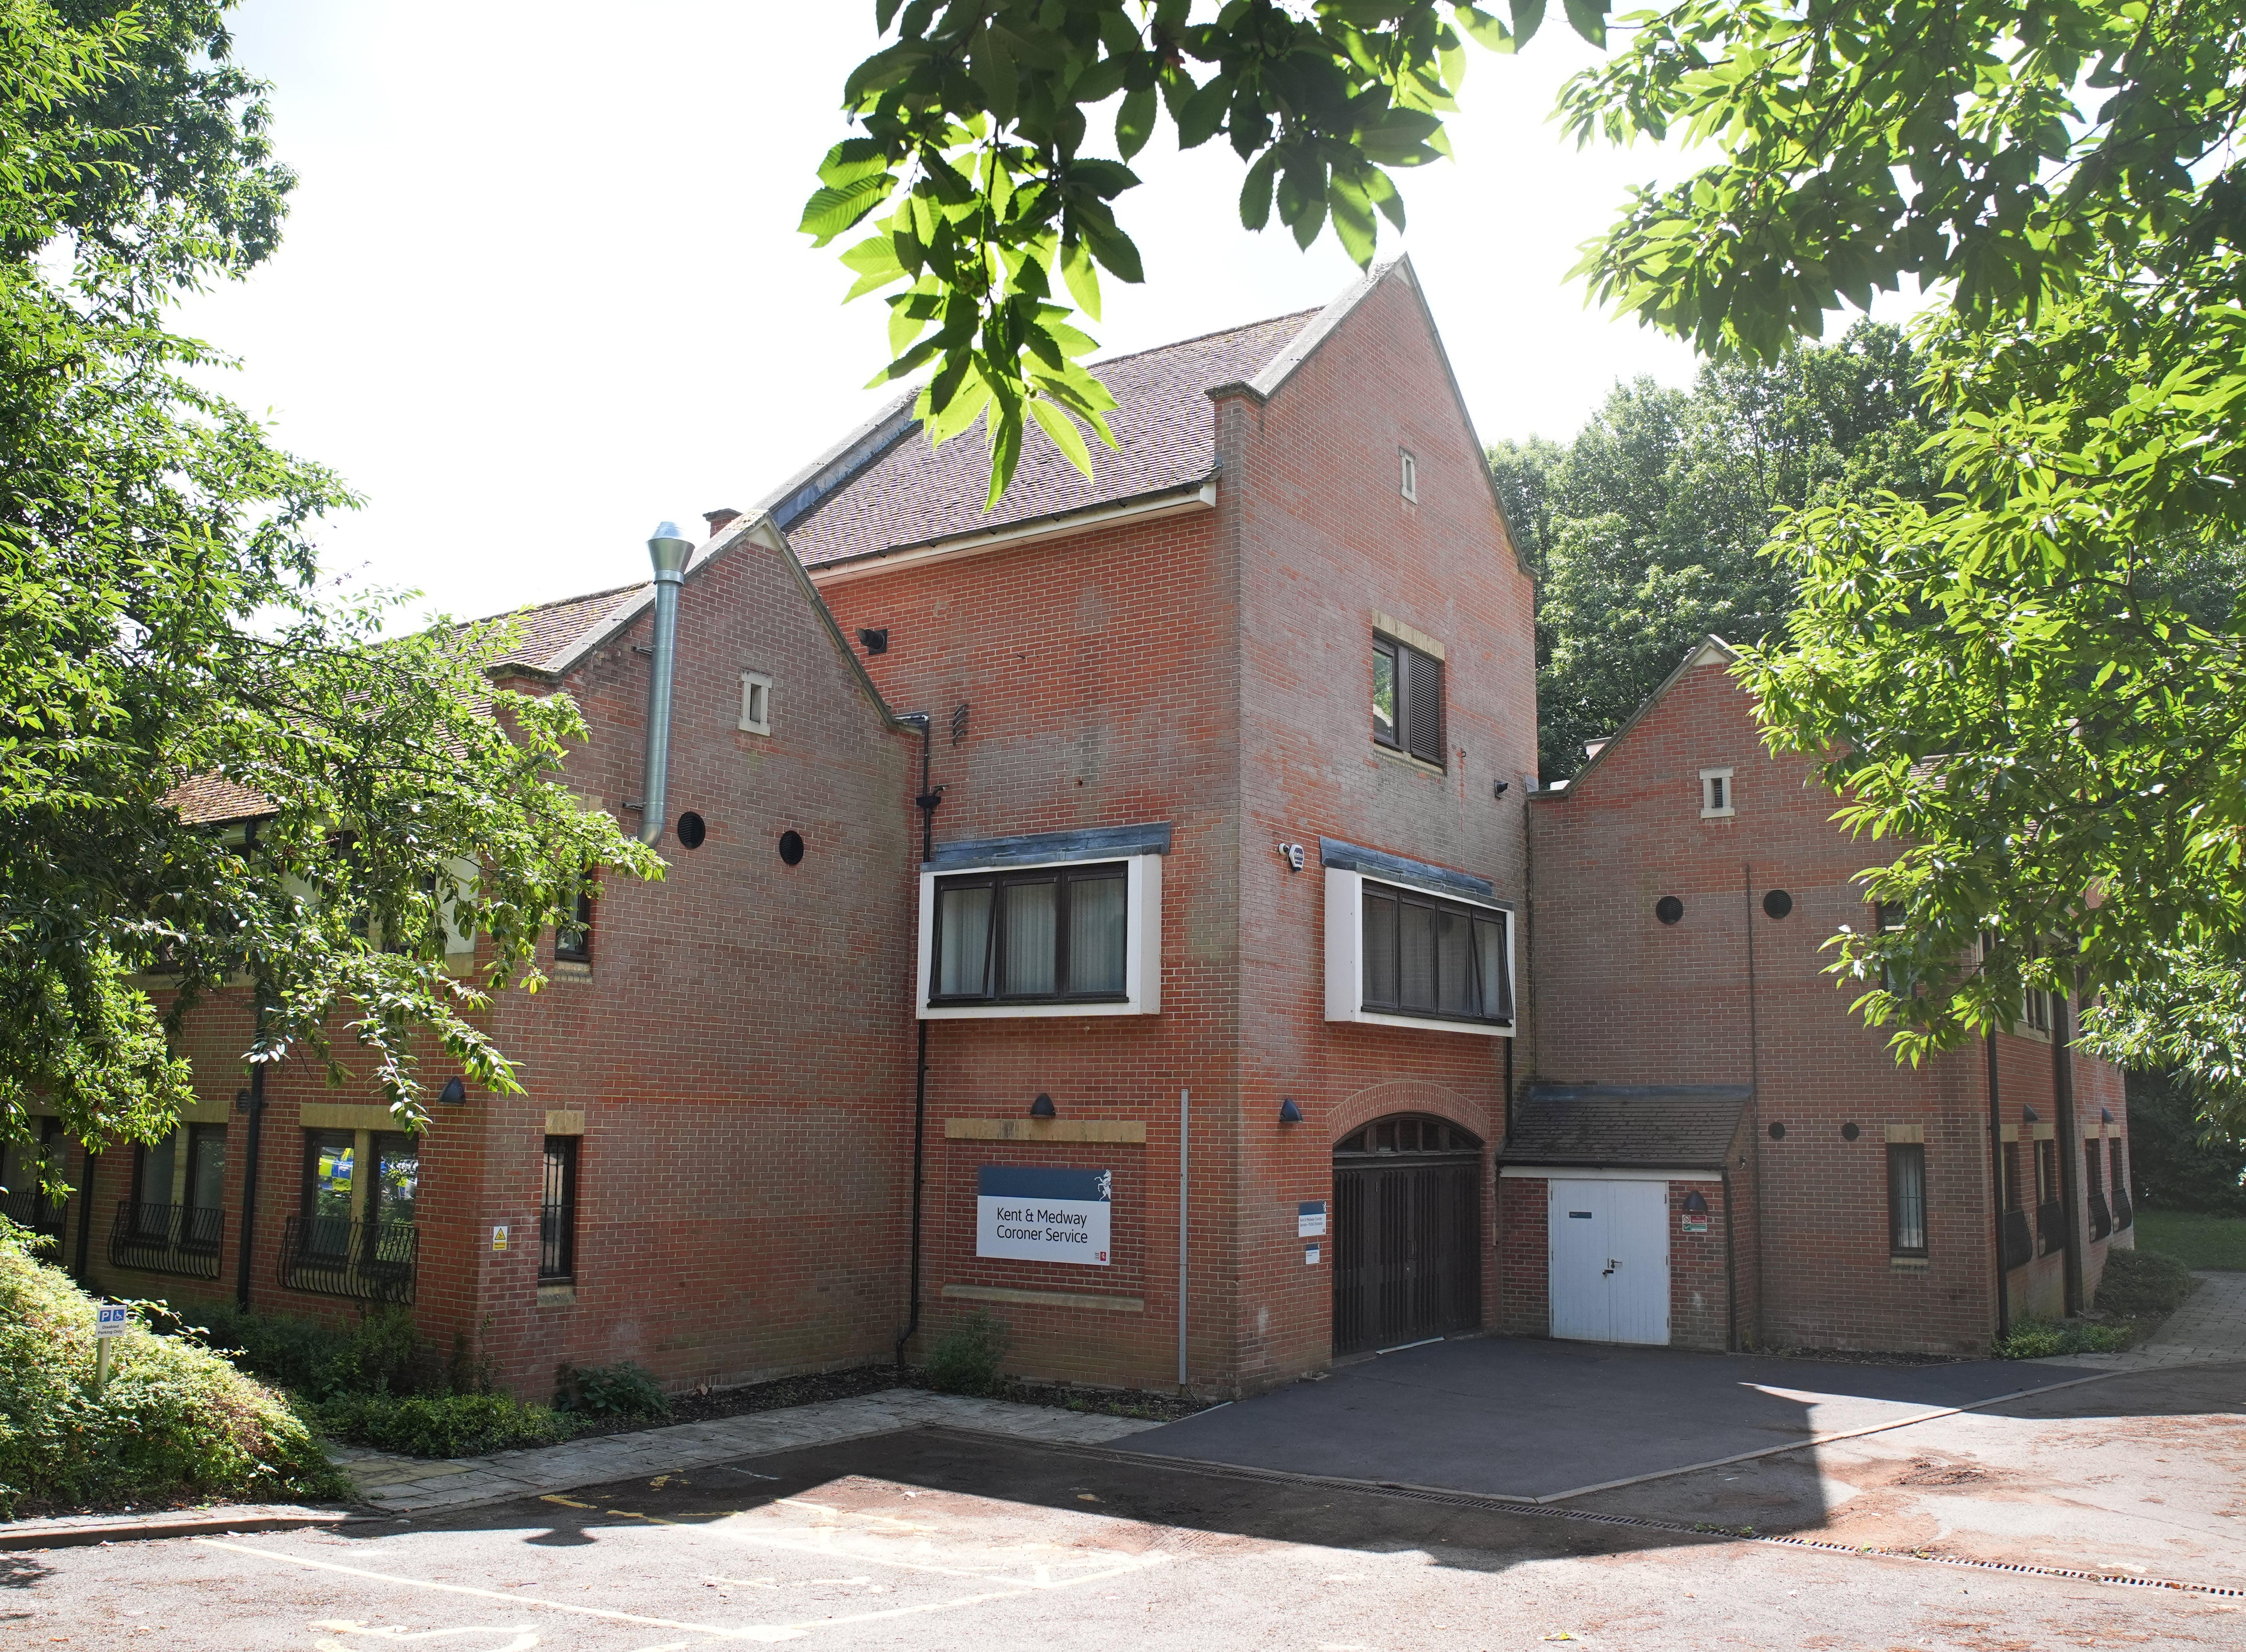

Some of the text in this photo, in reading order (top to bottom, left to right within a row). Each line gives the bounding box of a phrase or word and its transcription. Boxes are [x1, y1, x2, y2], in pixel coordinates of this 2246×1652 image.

[997, 1207, 1087, 1229] Kent & Medway
[997, 1225, 1087, 1243] Coroner Service
[101, 1312, 109, 1321] P
